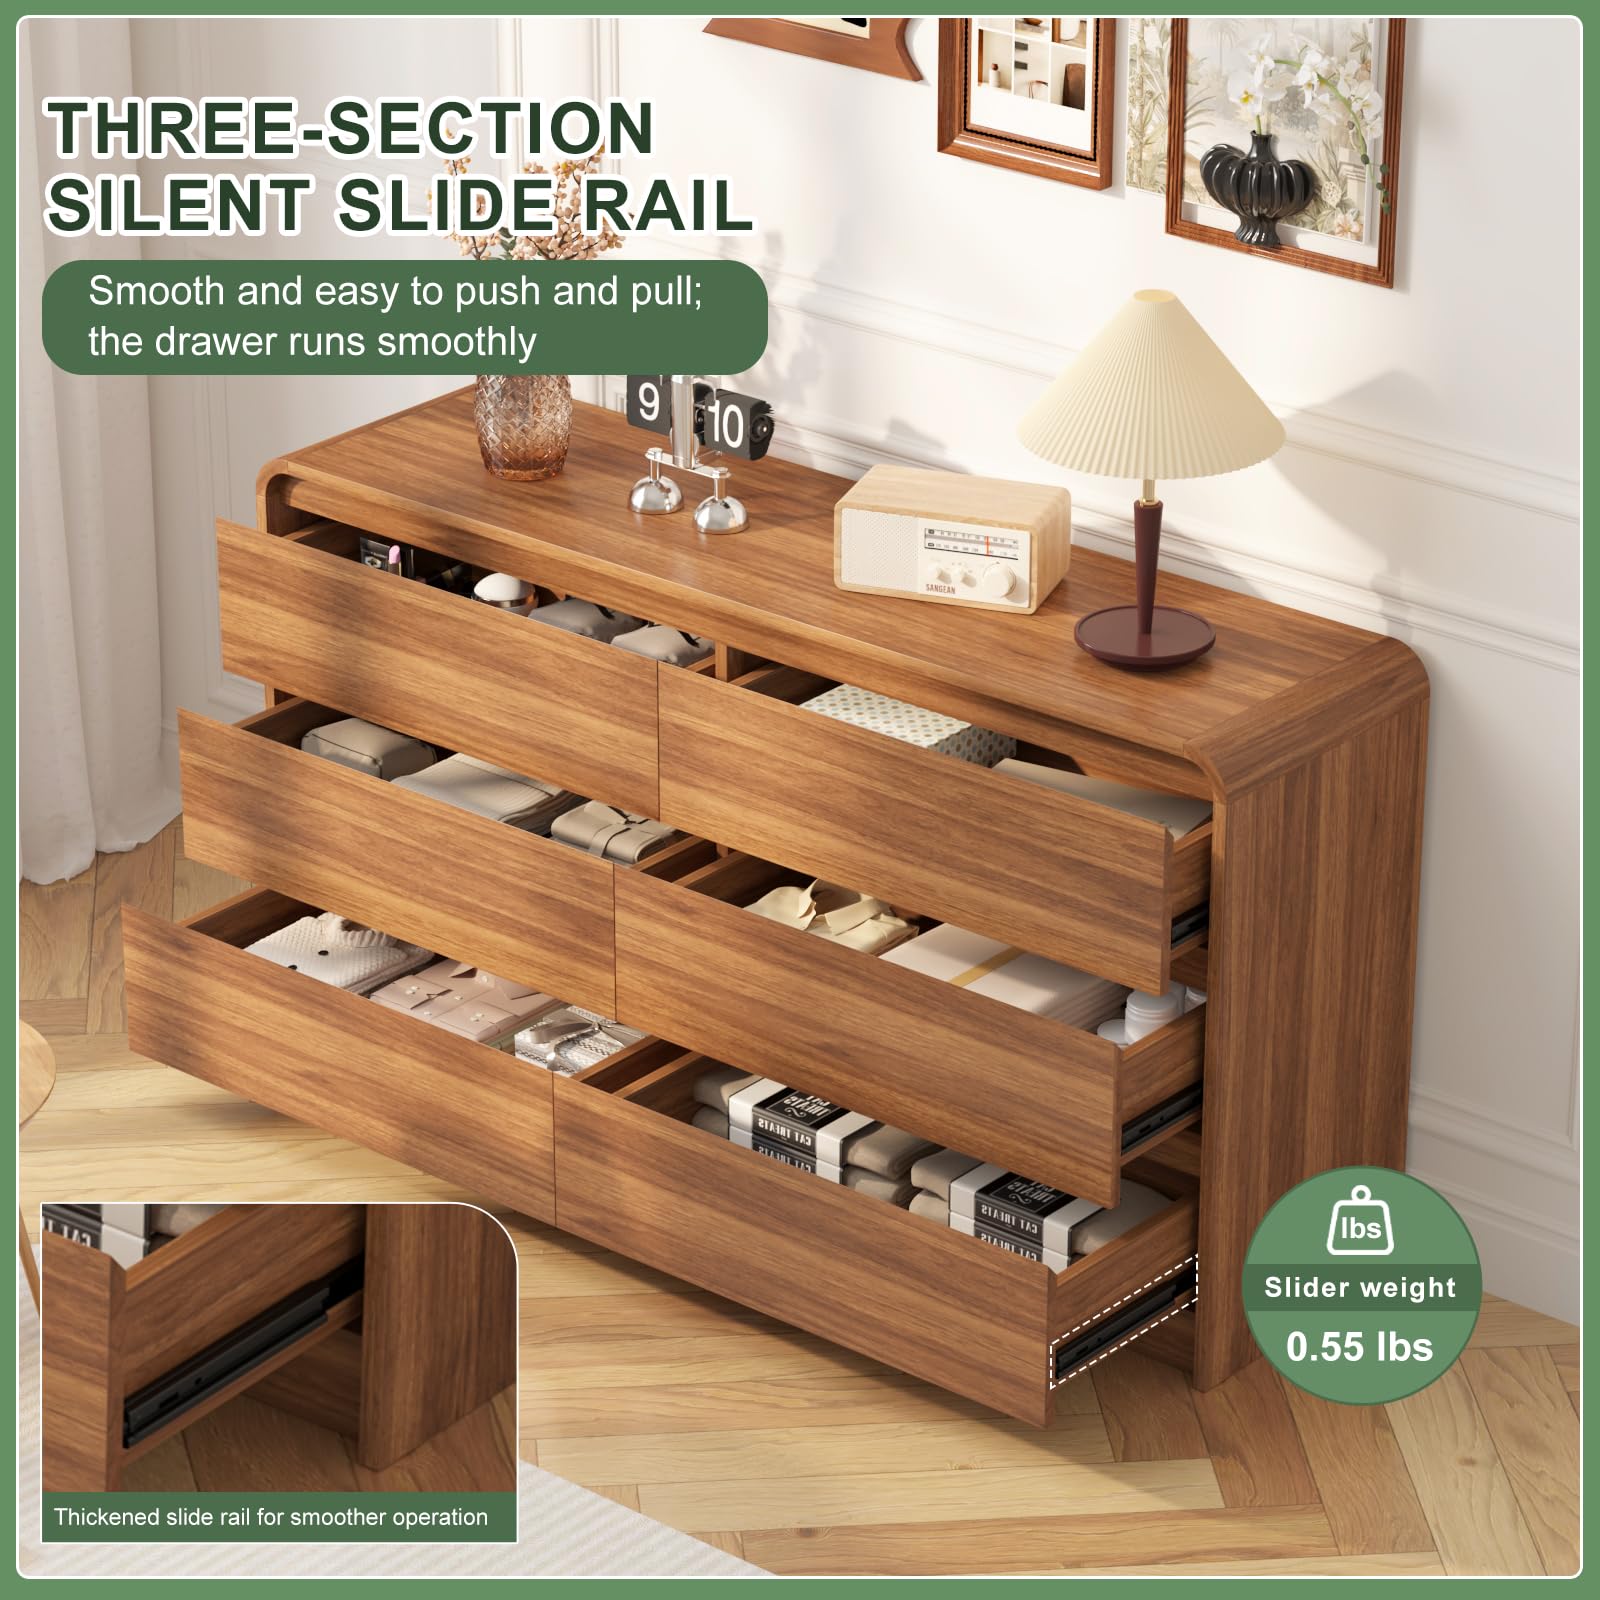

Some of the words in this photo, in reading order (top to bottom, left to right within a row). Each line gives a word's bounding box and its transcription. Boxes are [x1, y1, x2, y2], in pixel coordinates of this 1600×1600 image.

[638, 381, 661, 421] 9
[707, 399, 744, 449] 10
[925, 583, 956, 595] SANGEAN
